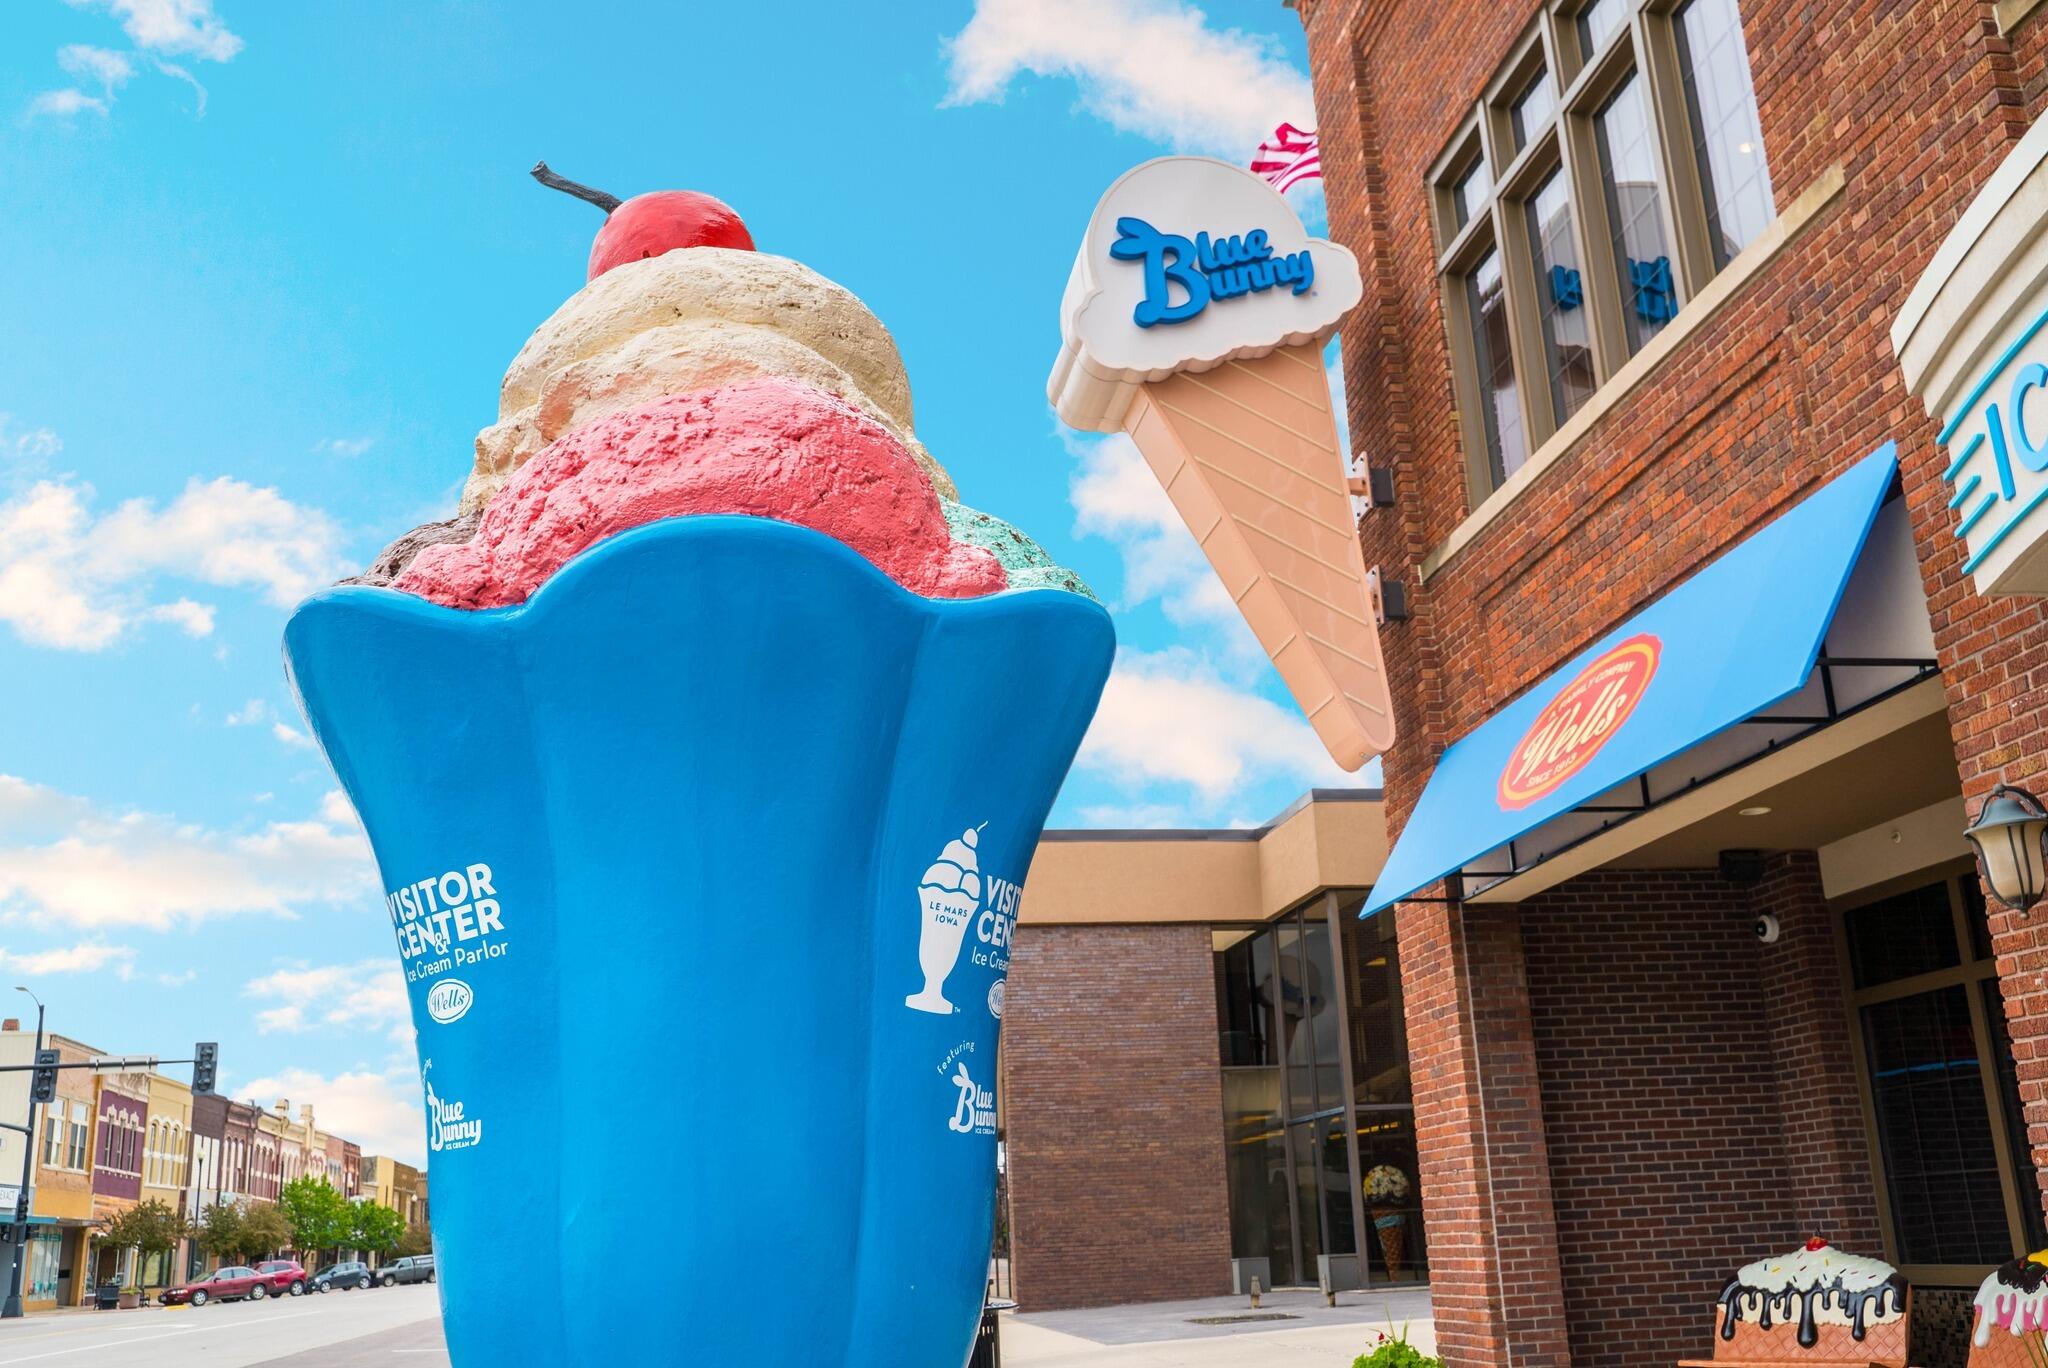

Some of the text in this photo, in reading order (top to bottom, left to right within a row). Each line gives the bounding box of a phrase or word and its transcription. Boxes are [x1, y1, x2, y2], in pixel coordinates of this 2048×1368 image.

[1110, 217, 1274, 328] Blue
[1512, 675, 1628, 787] Wells
[387, 863, 497, 925] VISITOR
[930, 901, 967, 918] LE MARS
[397, 899, 505, 960] CENTER
[935, 914, 958, 926] IOWA
[416, 957, 452, 979] Cream
[454, 940, 508, 967] Parlor
[434, 932, 449, 955] &
[971, 945, 988, 966] Ice
[432, 989, 464, 1012] Wells
[936, 1040, 975, 1075] featuring
[427, 1081, 465, 1152] Blue
[949, 1062, 993, 1133] Blue
